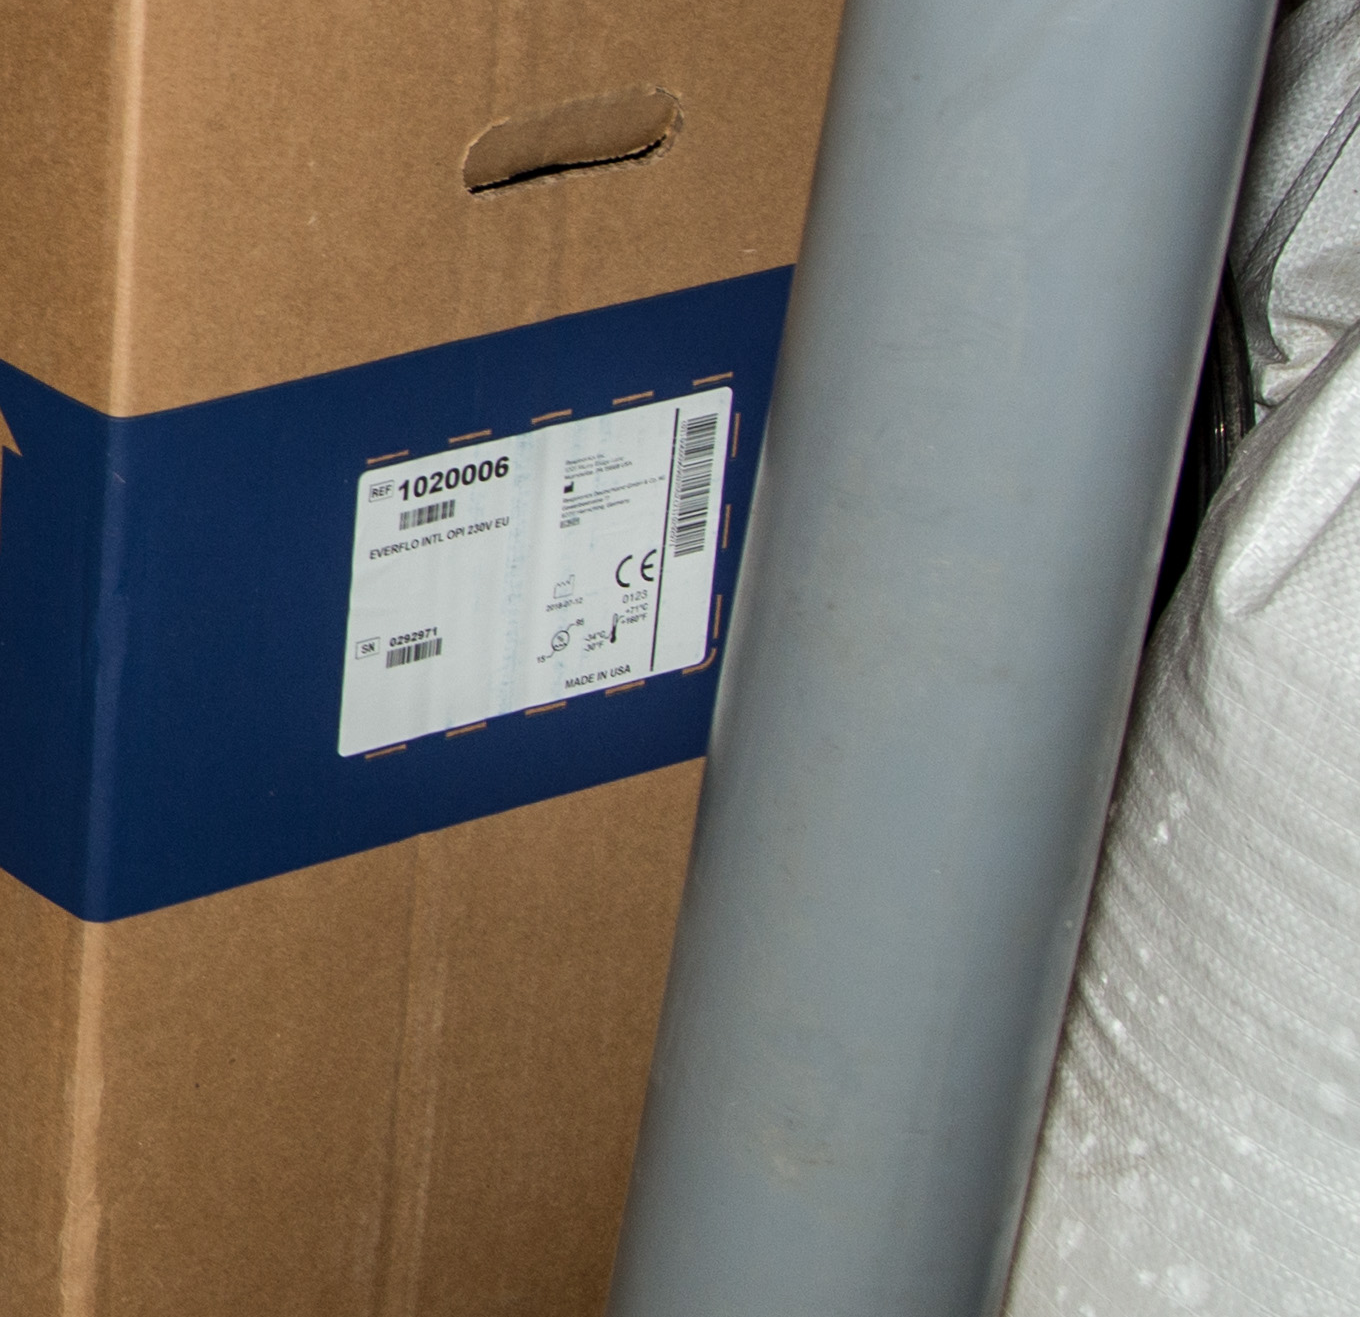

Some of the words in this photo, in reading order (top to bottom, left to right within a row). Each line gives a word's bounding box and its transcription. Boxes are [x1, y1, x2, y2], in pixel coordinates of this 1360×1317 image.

[371, 484, 392, 499] REF
[398, 455, 511, 502] 1020006
[369, 539, 420, 561] EVERFLO
[421, 532, 445, 550] INTL
[446, 526, 465, 542] OPI
[467, 520, 494, 537] 230V
[494, 516, 510, 530] EU
[622, 590, 648, 604] 0123
[360, 641, 377, 655] SN
[389, 626, 438, 647] 0292971
[565, 673, 596, 689] MADE
[596, 670, 608, 681] IN
[610, 664, 631, 677] USA
